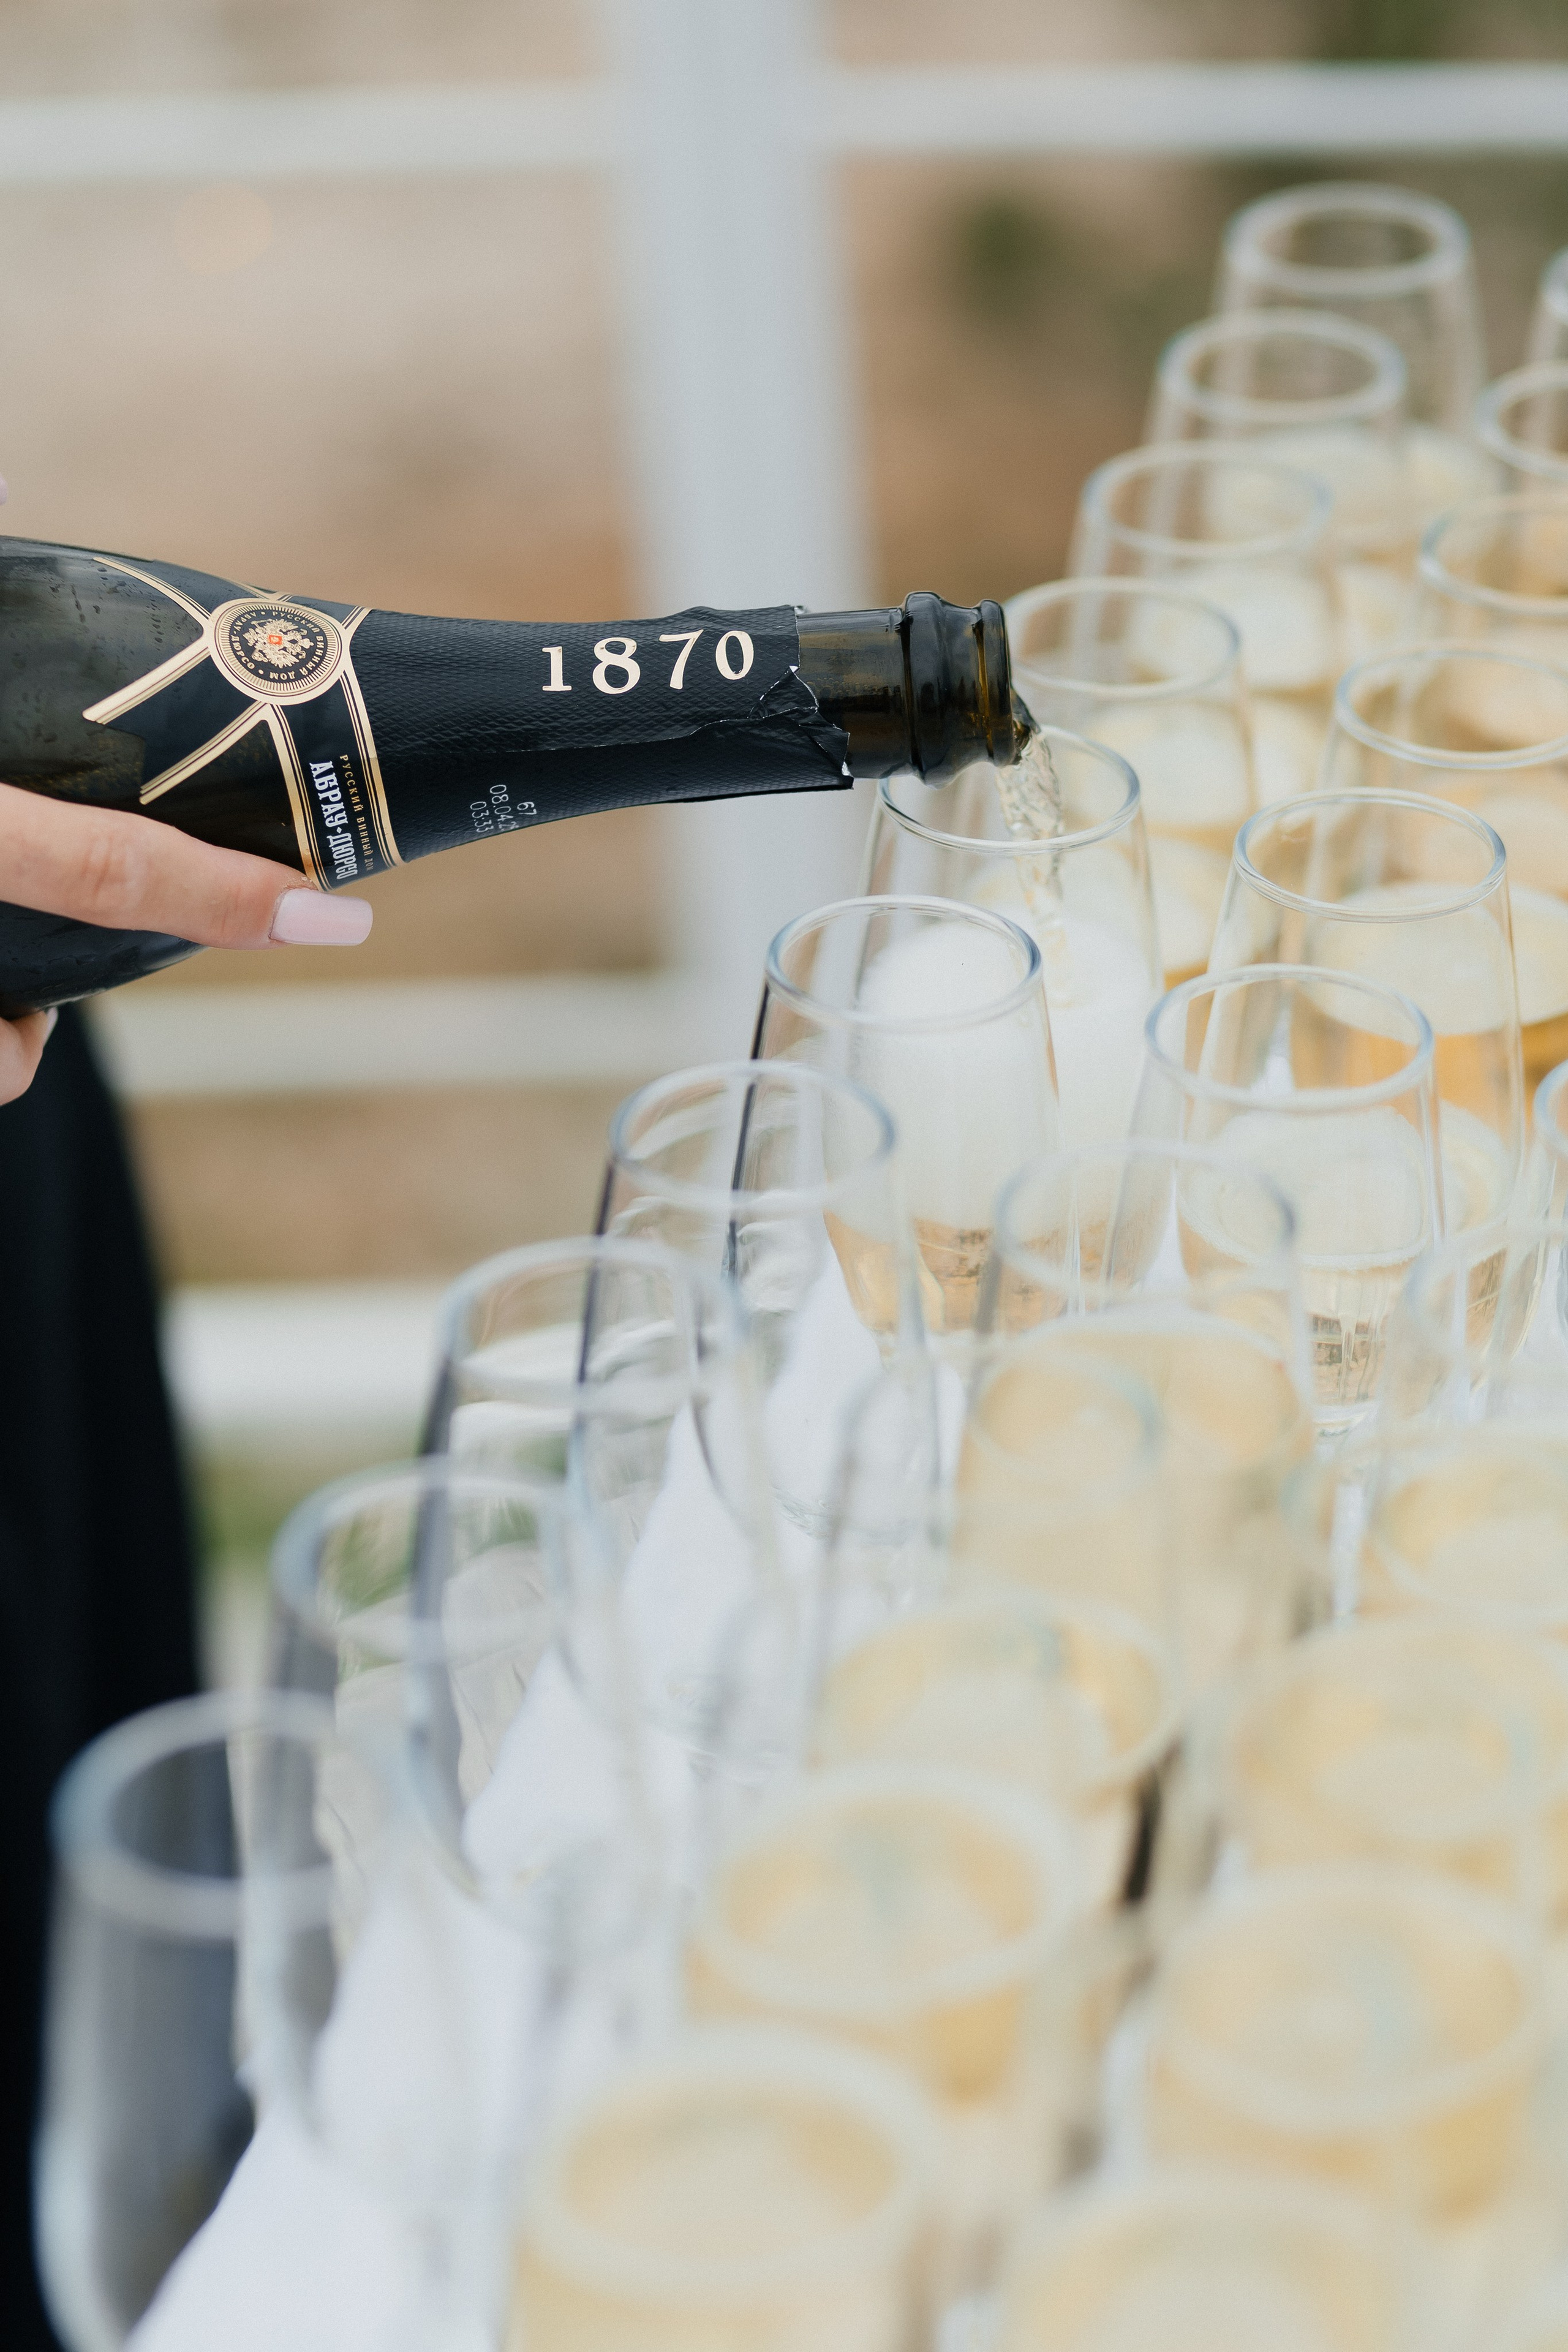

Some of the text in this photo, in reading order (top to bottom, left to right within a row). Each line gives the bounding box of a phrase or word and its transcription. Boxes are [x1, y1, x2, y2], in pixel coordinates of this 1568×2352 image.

[270, 611, 325, 680] РУССКИЙ ВИННЫЙ ДОМ
[541, 629, 755, 695] 1870
[339, 754, 374, 871] РУССКИЙ ВИННЫЙ ДОМ
[470, 801, 494, 832] 03:33
[516, 801, 537, 815] 67
